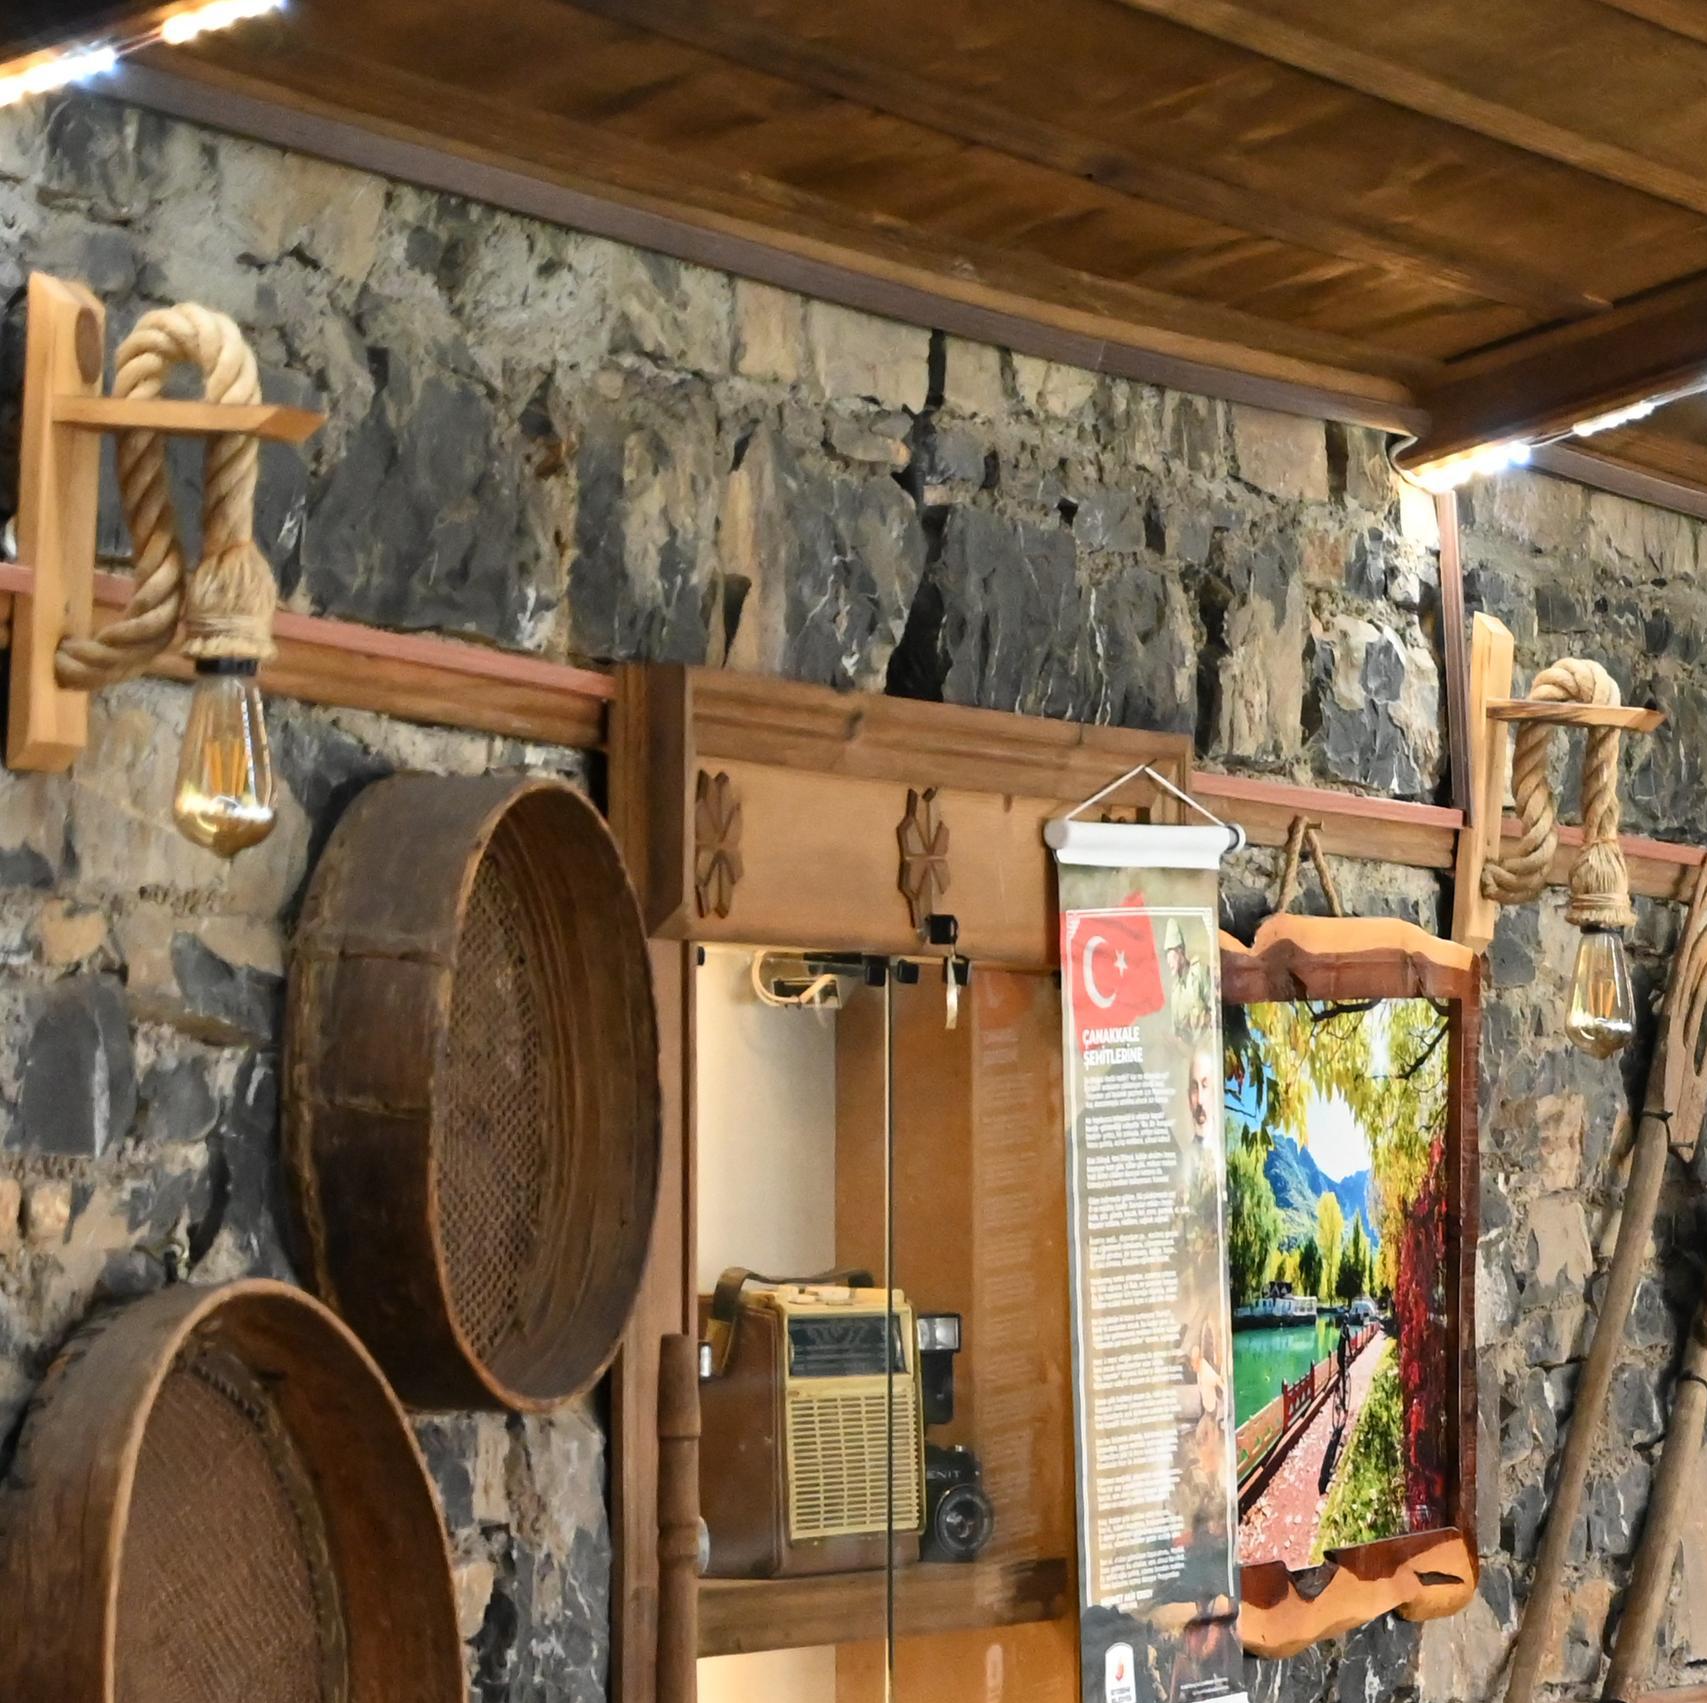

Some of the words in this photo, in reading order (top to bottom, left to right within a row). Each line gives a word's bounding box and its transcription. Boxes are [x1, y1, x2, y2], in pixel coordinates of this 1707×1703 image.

[1083, 1026, 1140, 1050] ÇANAKKALE
[1083, 1042, 1143, 1071] ŞEHİTLERİNE
[928, 1470, 960, 1479] ENIT
